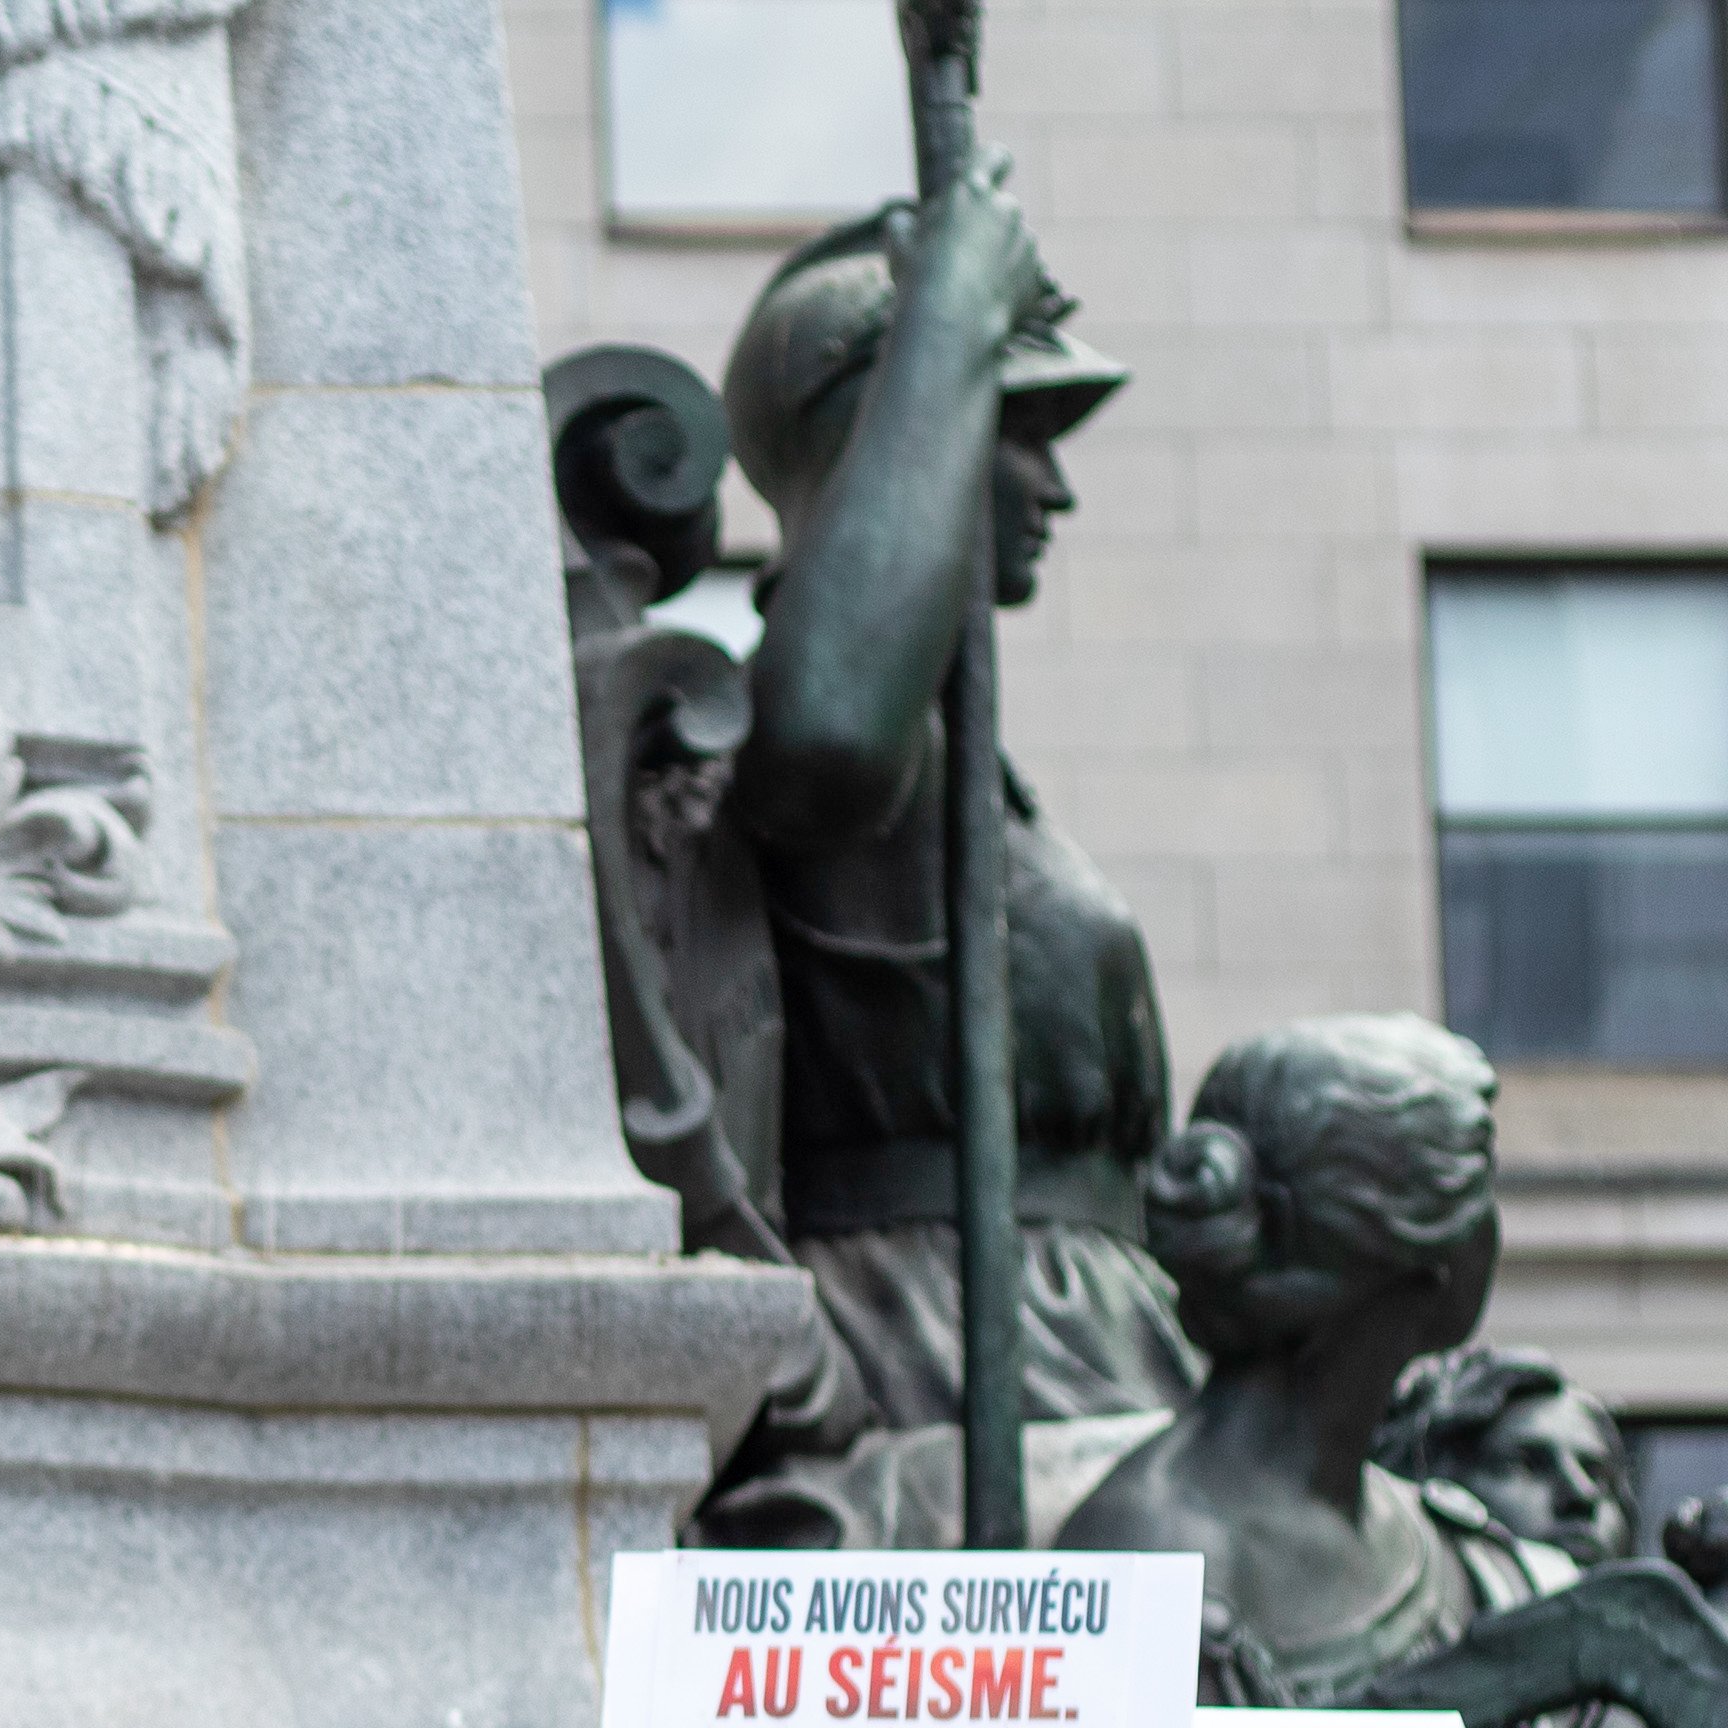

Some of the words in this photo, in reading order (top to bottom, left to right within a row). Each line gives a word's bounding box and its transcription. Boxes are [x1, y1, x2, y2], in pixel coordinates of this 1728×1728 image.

[693, 1578, 793, 1635] NOUS
[804, 1578, 927, 1635] AVONS
[940, 1574, 1111, 1636] SURVÉCU
[717, 1646, 803, 1718] AU
[826, 1637, 1080, 1721] SÉISME.
